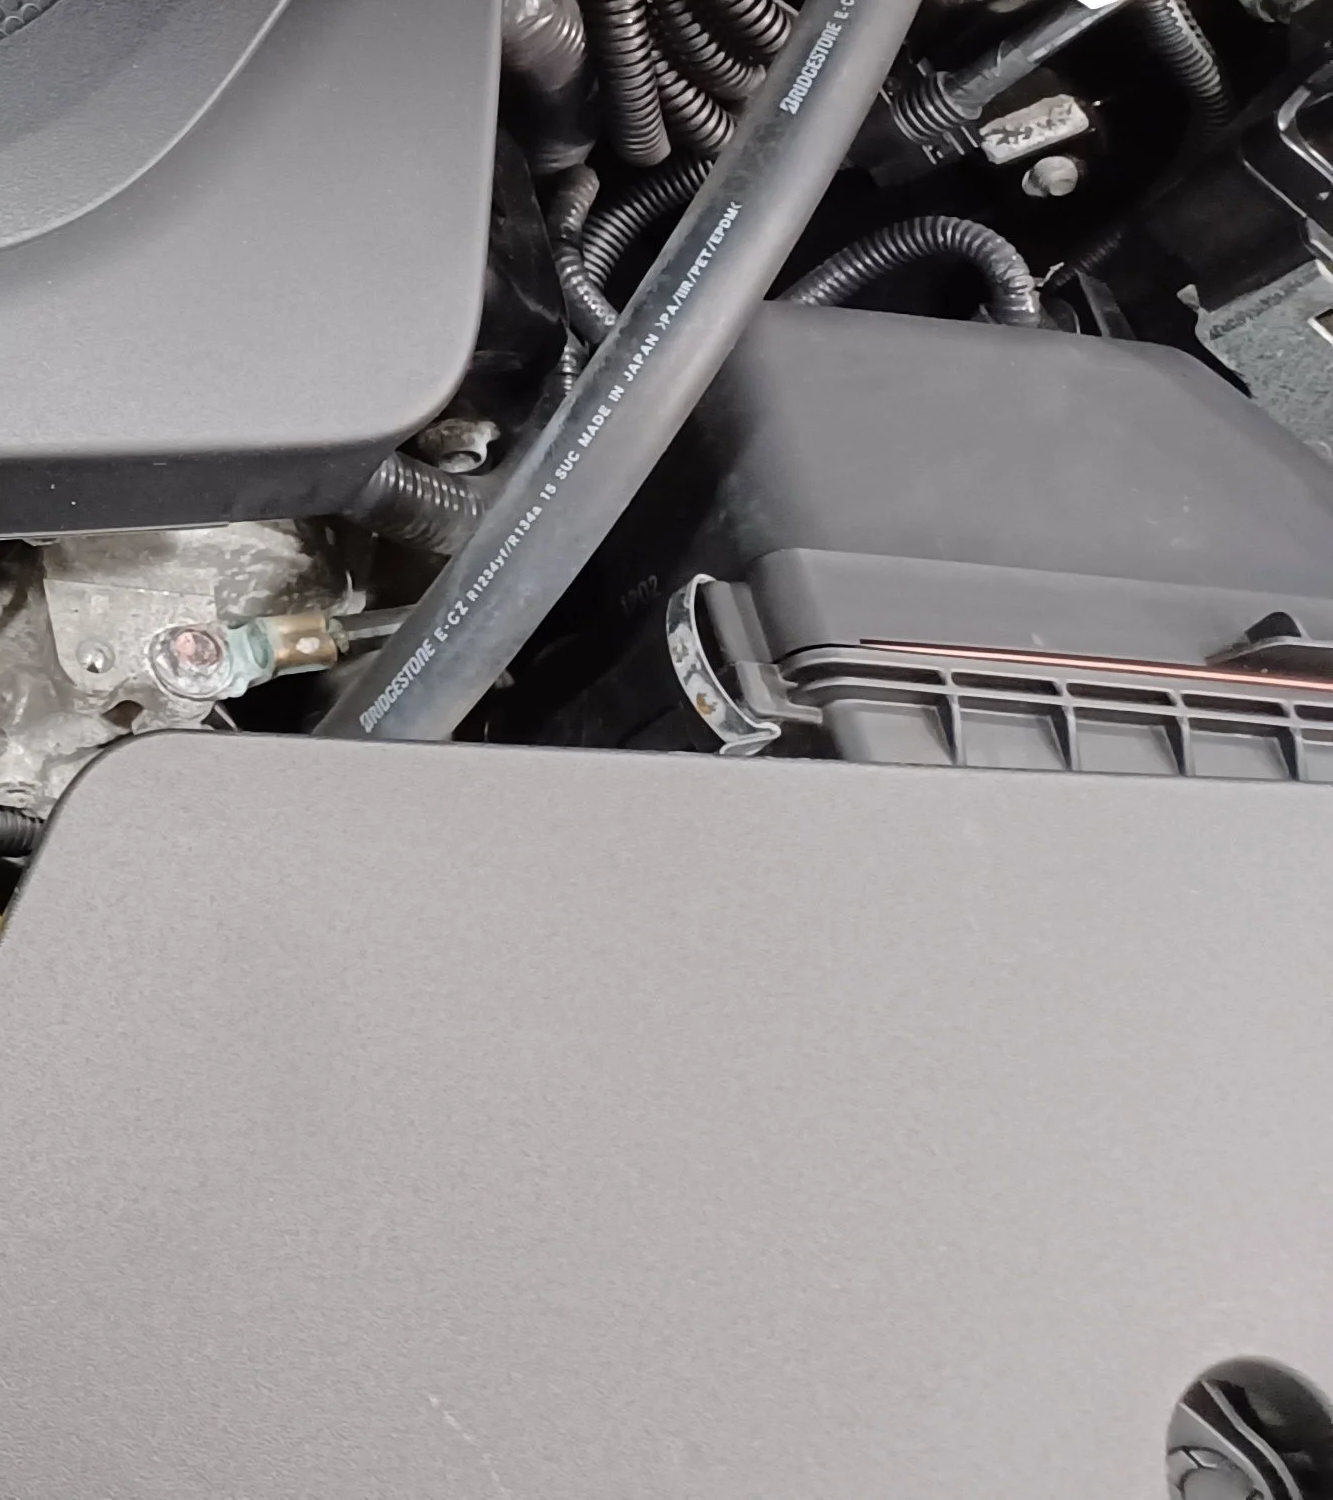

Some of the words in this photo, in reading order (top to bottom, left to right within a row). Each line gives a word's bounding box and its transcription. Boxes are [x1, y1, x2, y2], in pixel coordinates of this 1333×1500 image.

[779, 20, 843, 116] BRIDGESTONE
[359, 638, 437, 734] BRIDGESTONE
[554, 450, 581, 481] SUC
[577, 404, 613, 449] MADE
[607, 384, 625, 403] IN
[623, 332, 660, 382] JAPAN
